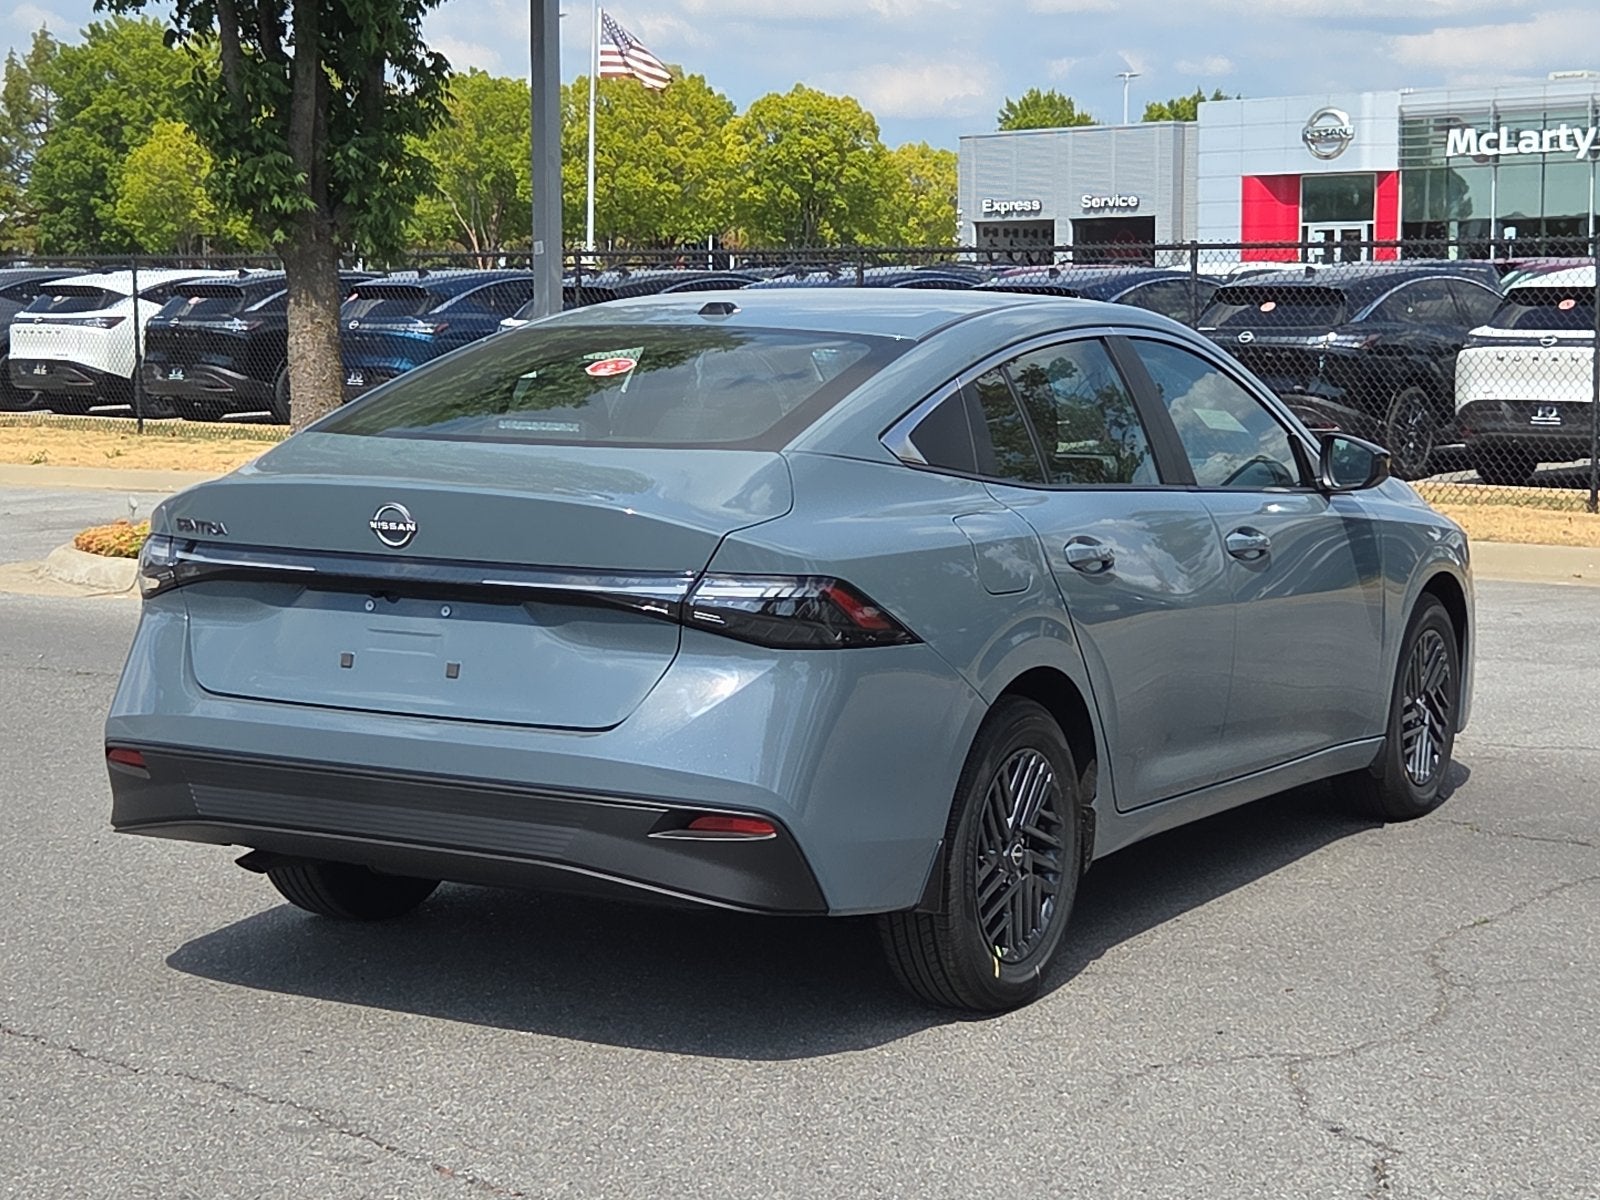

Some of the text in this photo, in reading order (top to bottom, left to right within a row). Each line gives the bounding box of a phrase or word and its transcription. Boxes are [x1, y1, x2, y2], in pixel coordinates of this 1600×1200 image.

[1446, 124, 1596, 159] McLarty
[982, 199, 1041, 214] Express
[1081, 194, 1138, 208] Service
[370, 521, 416, 532] NISSAN
